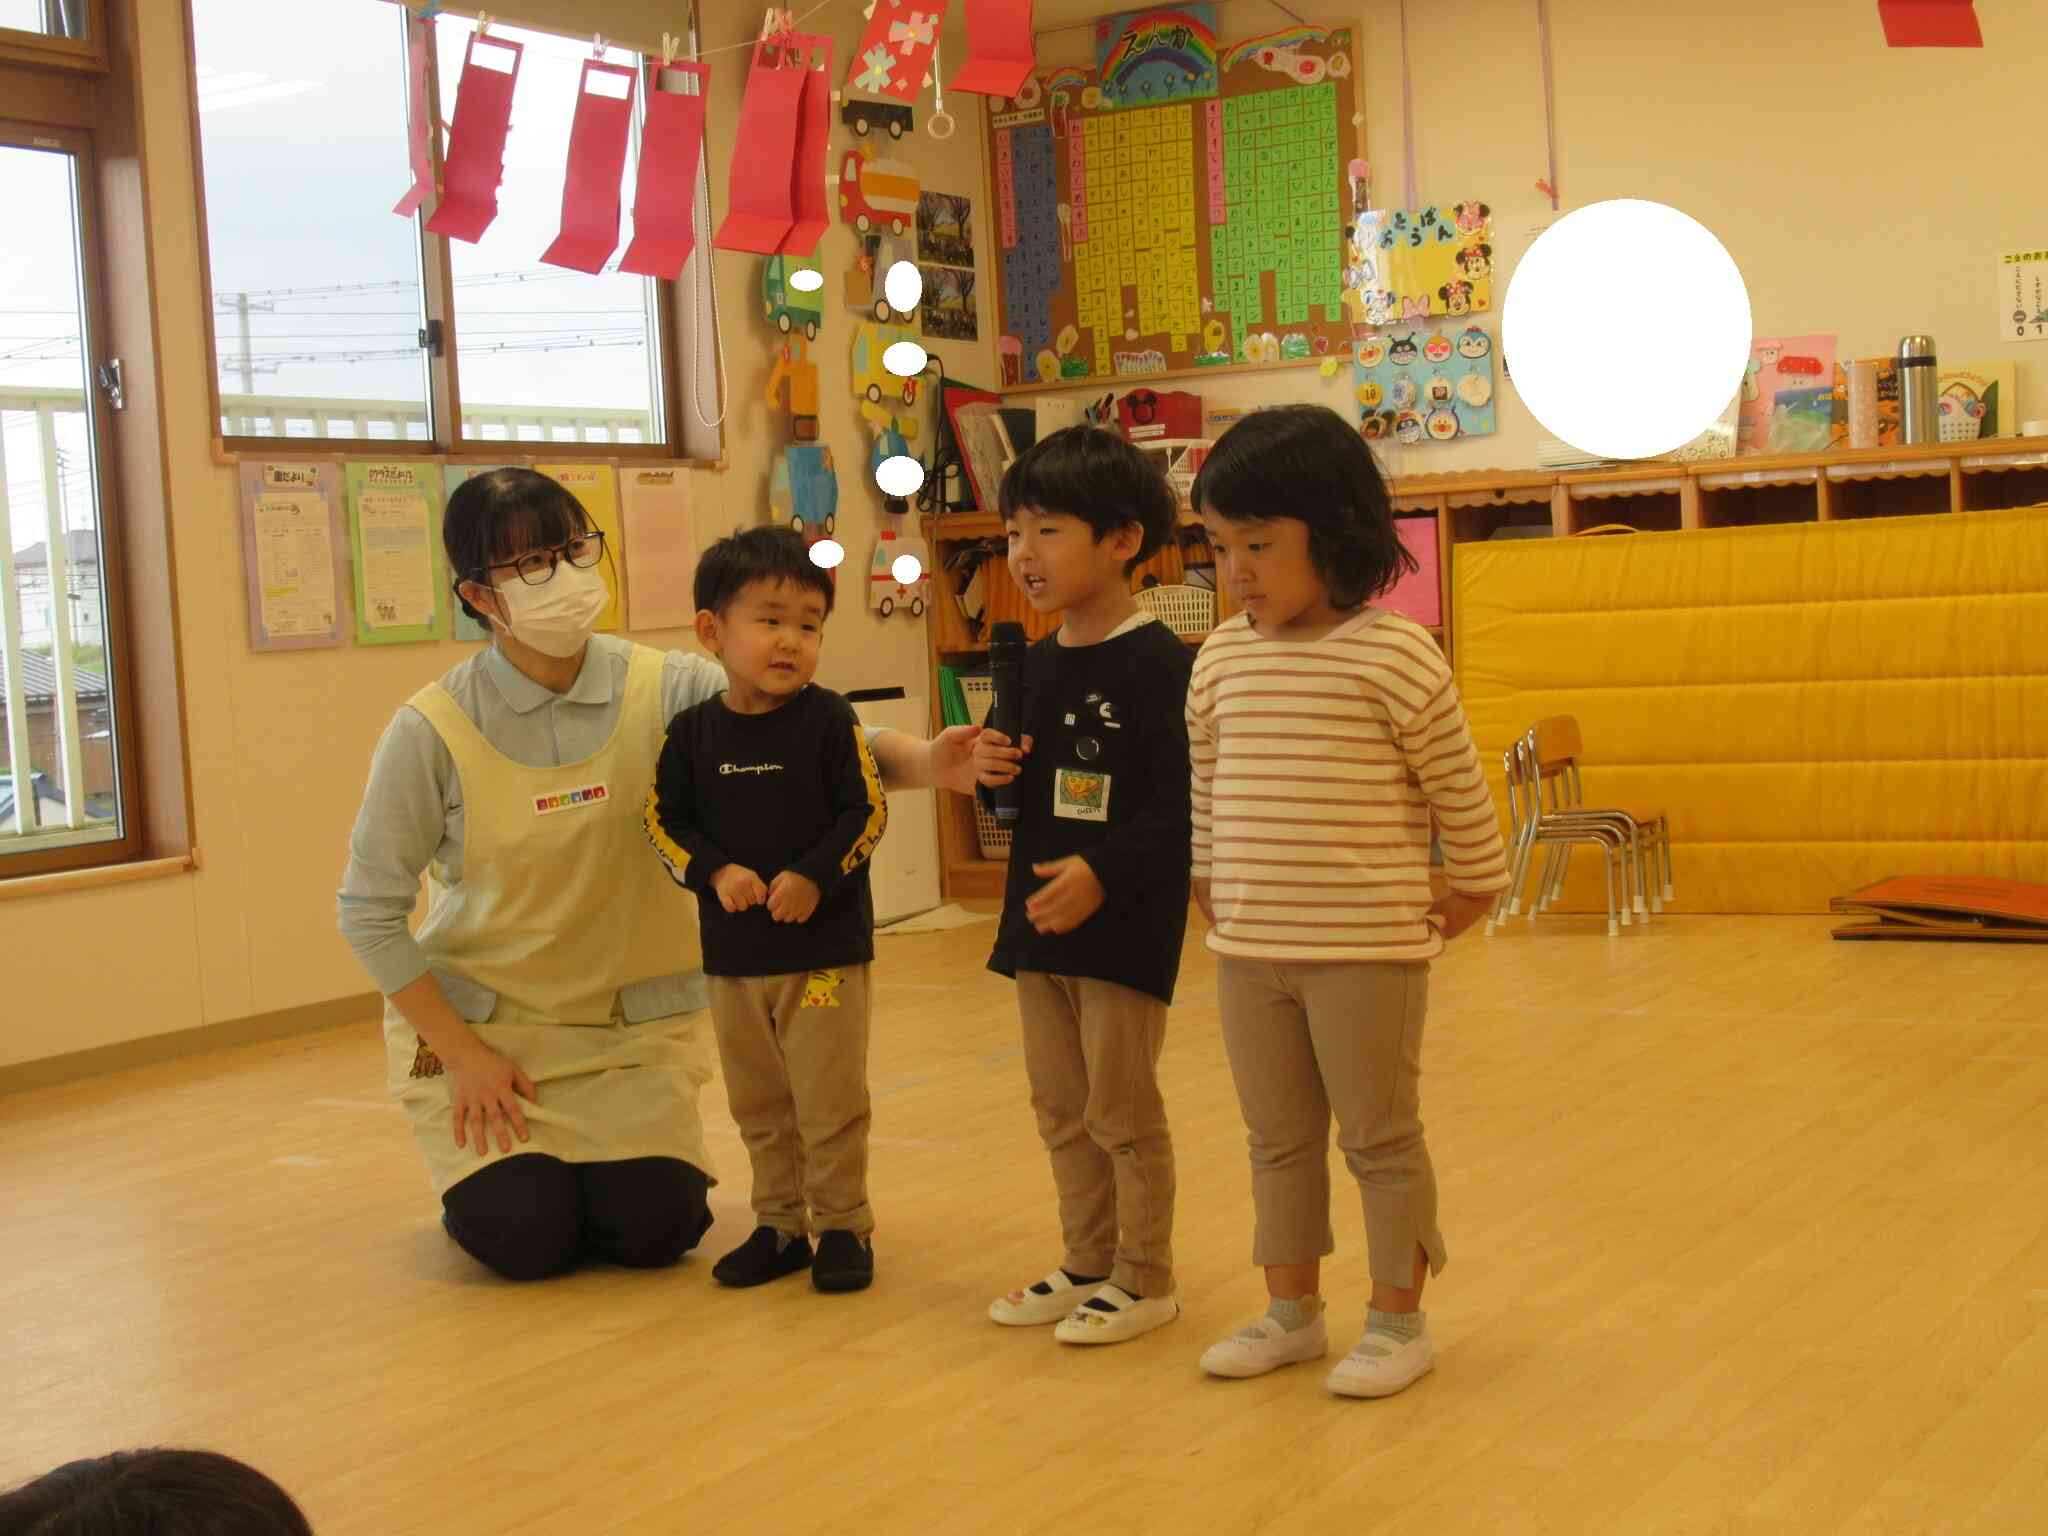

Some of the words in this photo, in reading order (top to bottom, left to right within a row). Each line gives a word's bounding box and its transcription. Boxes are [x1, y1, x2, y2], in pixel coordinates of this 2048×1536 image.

[1120, 22, 1194, 61] えんか
[1380, 206, 1453, 249] おとうばん
[2017, 325, 2025, 337] 0
[2036, 323, 2042, 334] 1
[719, 763, 785, 775] Champion
